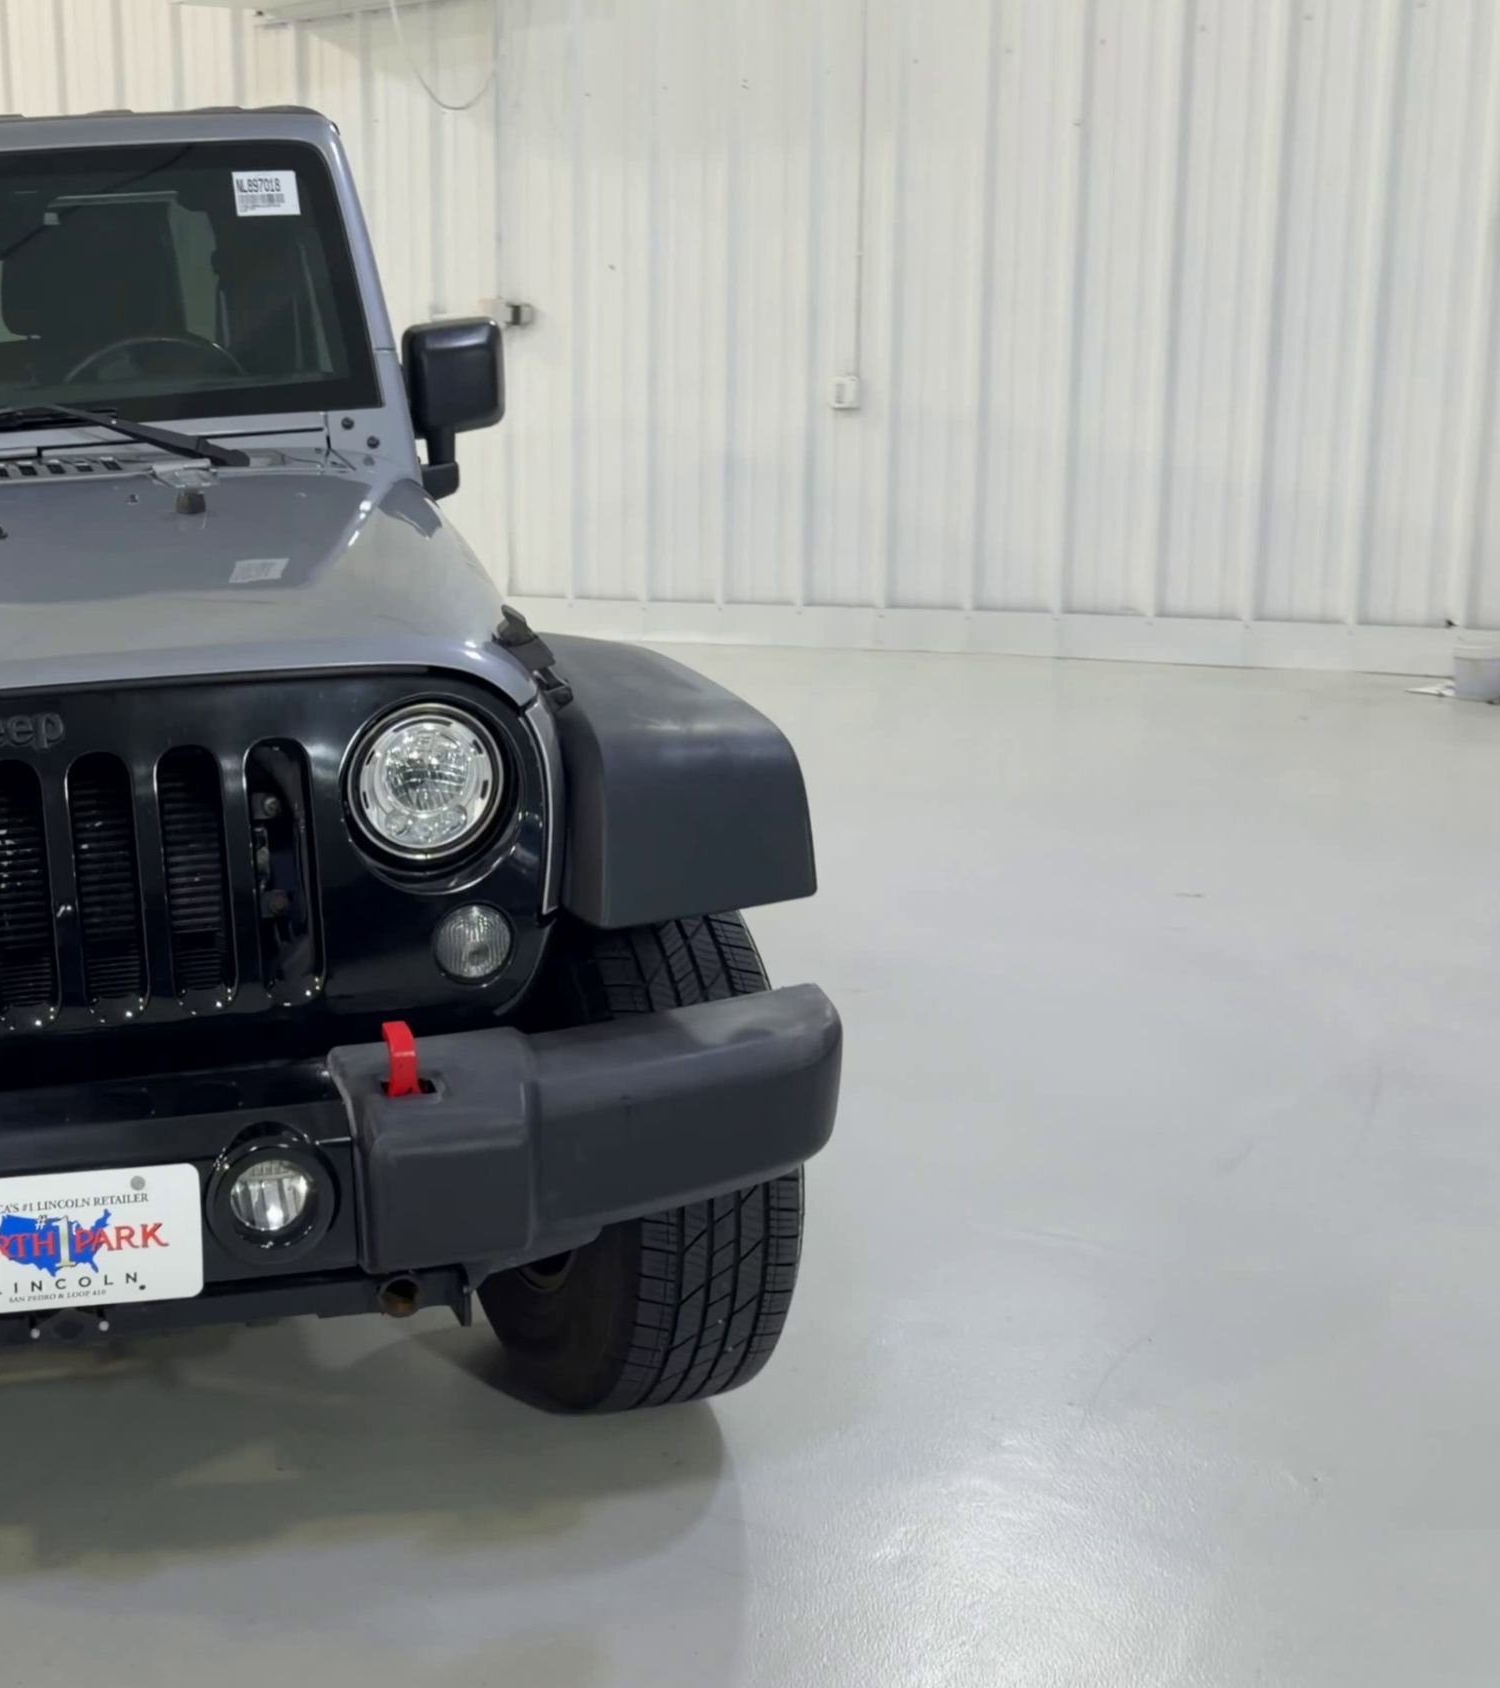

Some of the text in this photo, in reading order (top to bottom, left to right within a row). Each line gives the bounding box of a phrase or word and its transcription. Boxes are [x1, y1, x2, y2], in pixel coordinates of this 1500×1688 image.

[22, 1202, 34, 1212] #1
[37, 1197, 90, 1211] LINCOLN
[93, 1193, 149, 1206] RETAILER
[75, 1222, 170, 1254] PARK
[9, 1295, 25, 1303] SAN
[27, 1292, 56, 1302] PEDRO
[67, 1290, 90, 1298] LOOP
